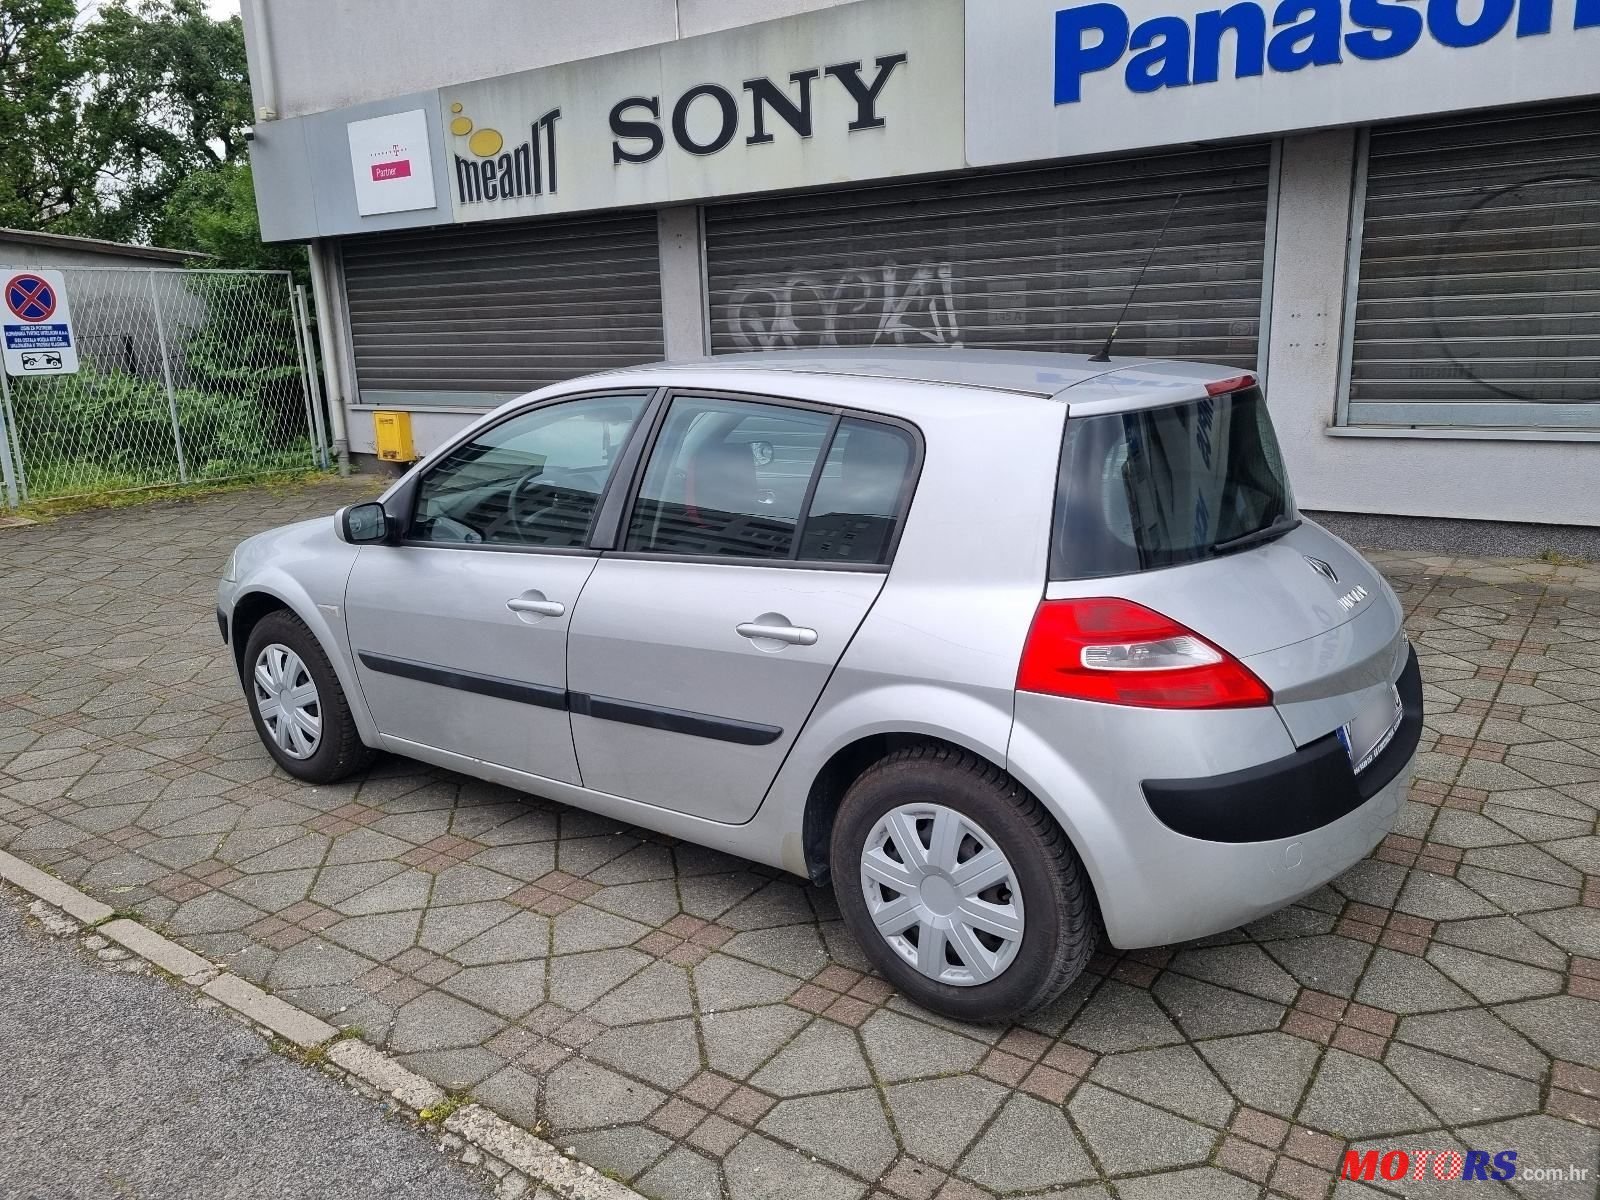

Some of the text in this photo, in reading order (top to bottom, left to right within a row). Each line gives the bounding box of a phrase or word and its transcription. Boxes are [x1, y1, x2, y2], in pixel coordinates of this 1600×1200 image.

[454, 106, 562, 204] meanIT
[609, 51, 908, 165] SONY
[376, 168, 397, 178] Partner
